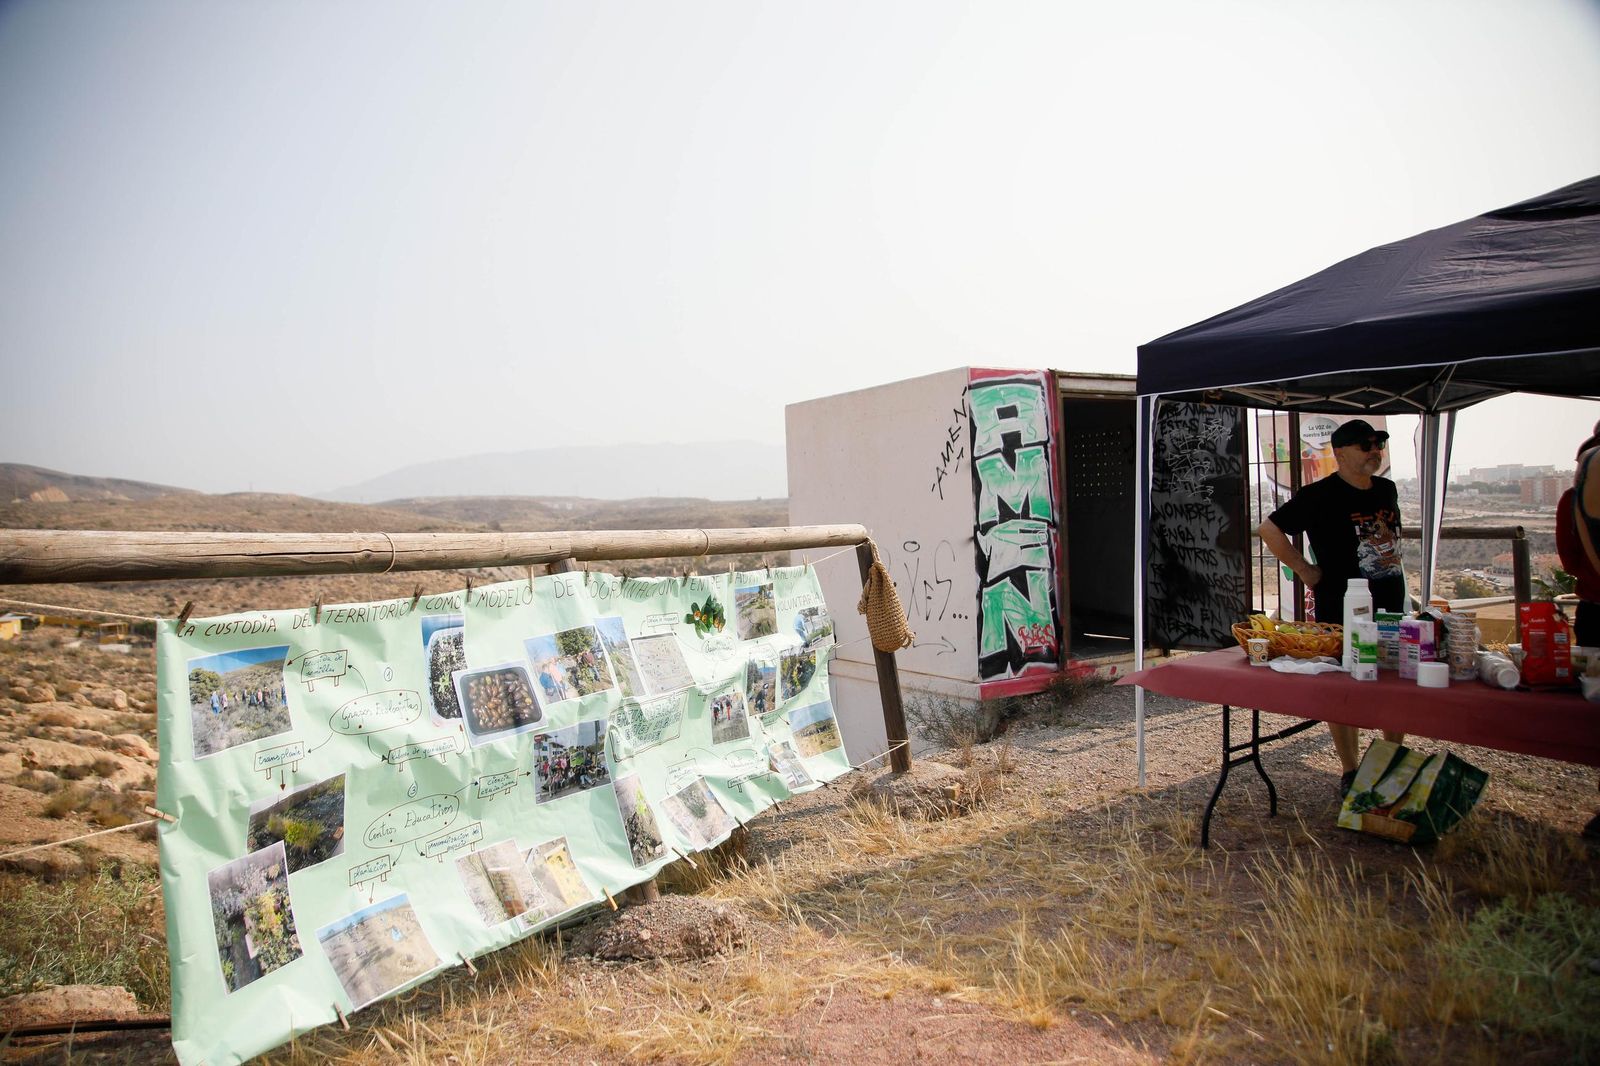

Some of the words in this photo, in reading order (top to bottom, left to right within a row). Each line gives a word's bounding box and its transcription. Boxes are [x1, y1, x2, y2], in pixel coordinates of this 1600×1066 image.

[425, 596, 461, 610] COMO
[476, 585, 534, 608] MODELO
[554, 578, 575, 599] DE
